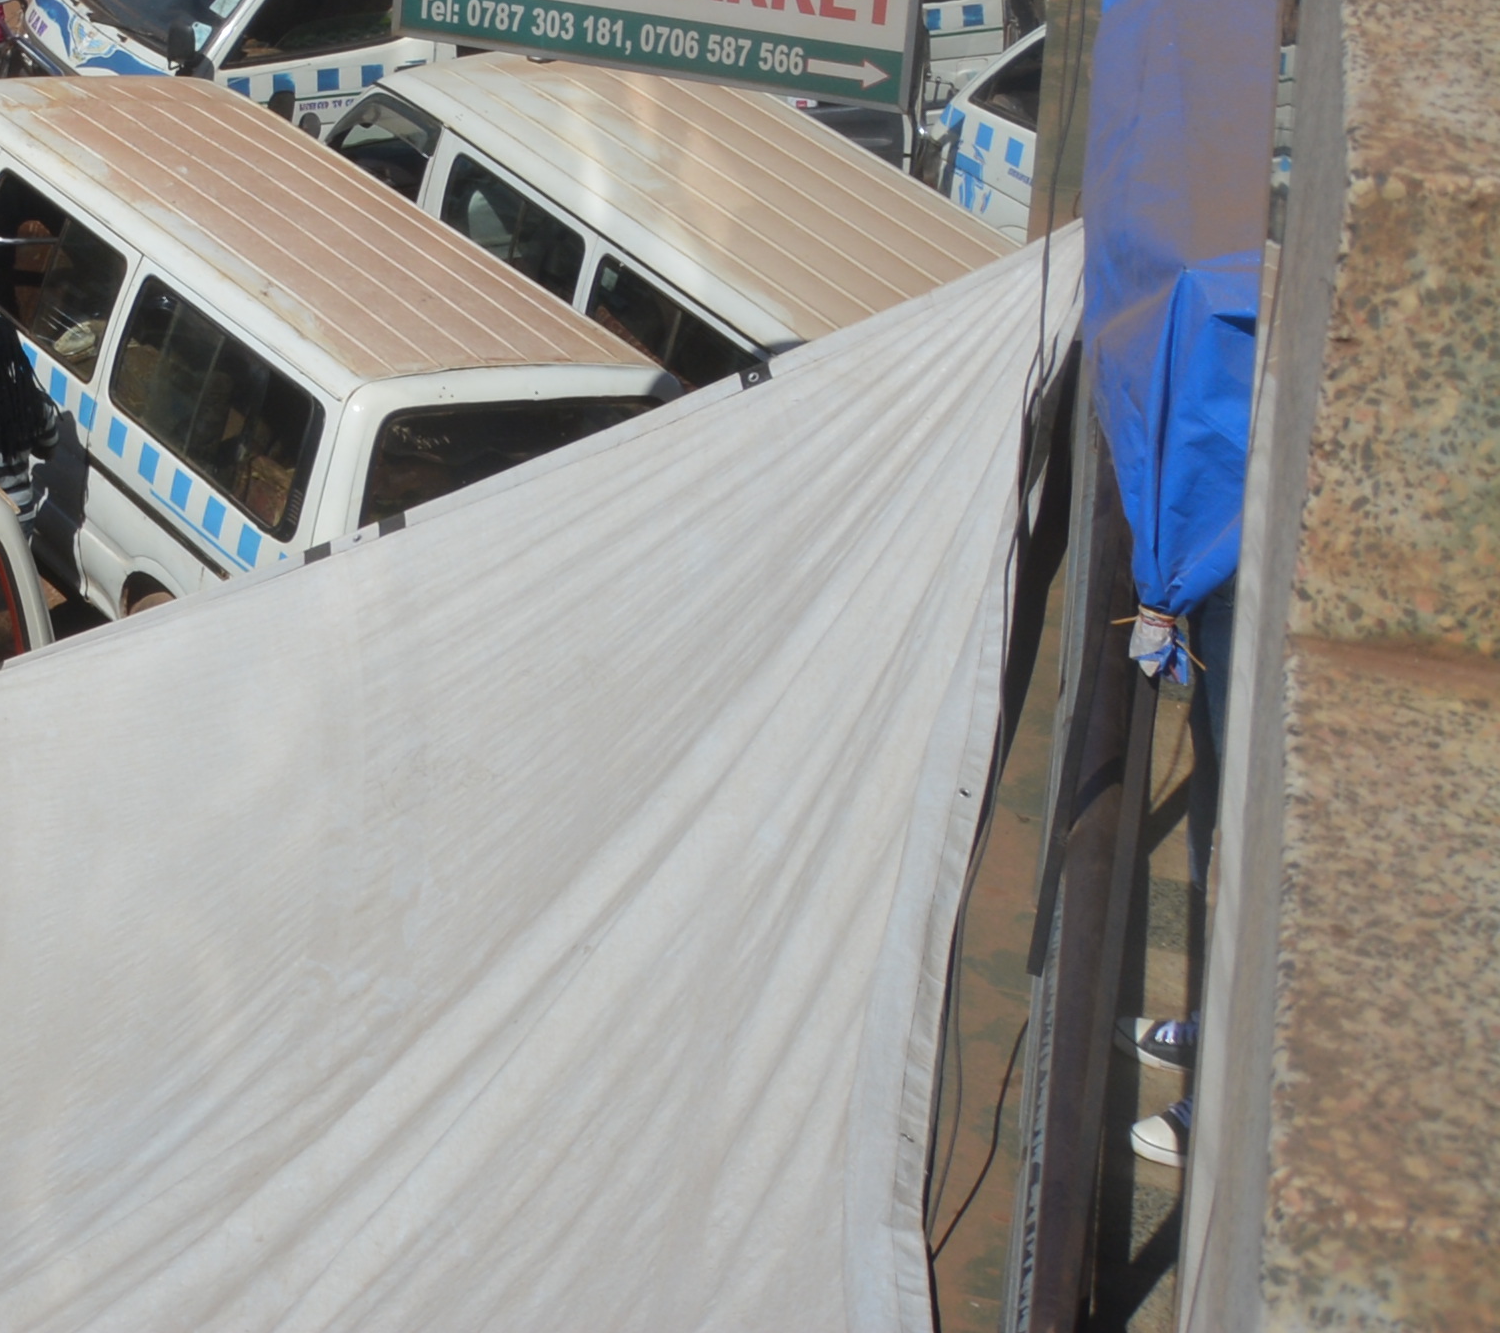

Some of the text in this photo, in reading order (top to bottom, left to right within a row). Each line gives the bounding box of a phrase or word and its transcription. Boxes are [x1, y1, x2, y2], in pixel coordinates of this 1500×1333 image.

[531, 6, 575, 41] 303
[581, 15, 633, 57] 181,
[639, 24, 700, 60] 0706
[706, 34, 752, 69] 587
[758, 42, 805, 77] 566
